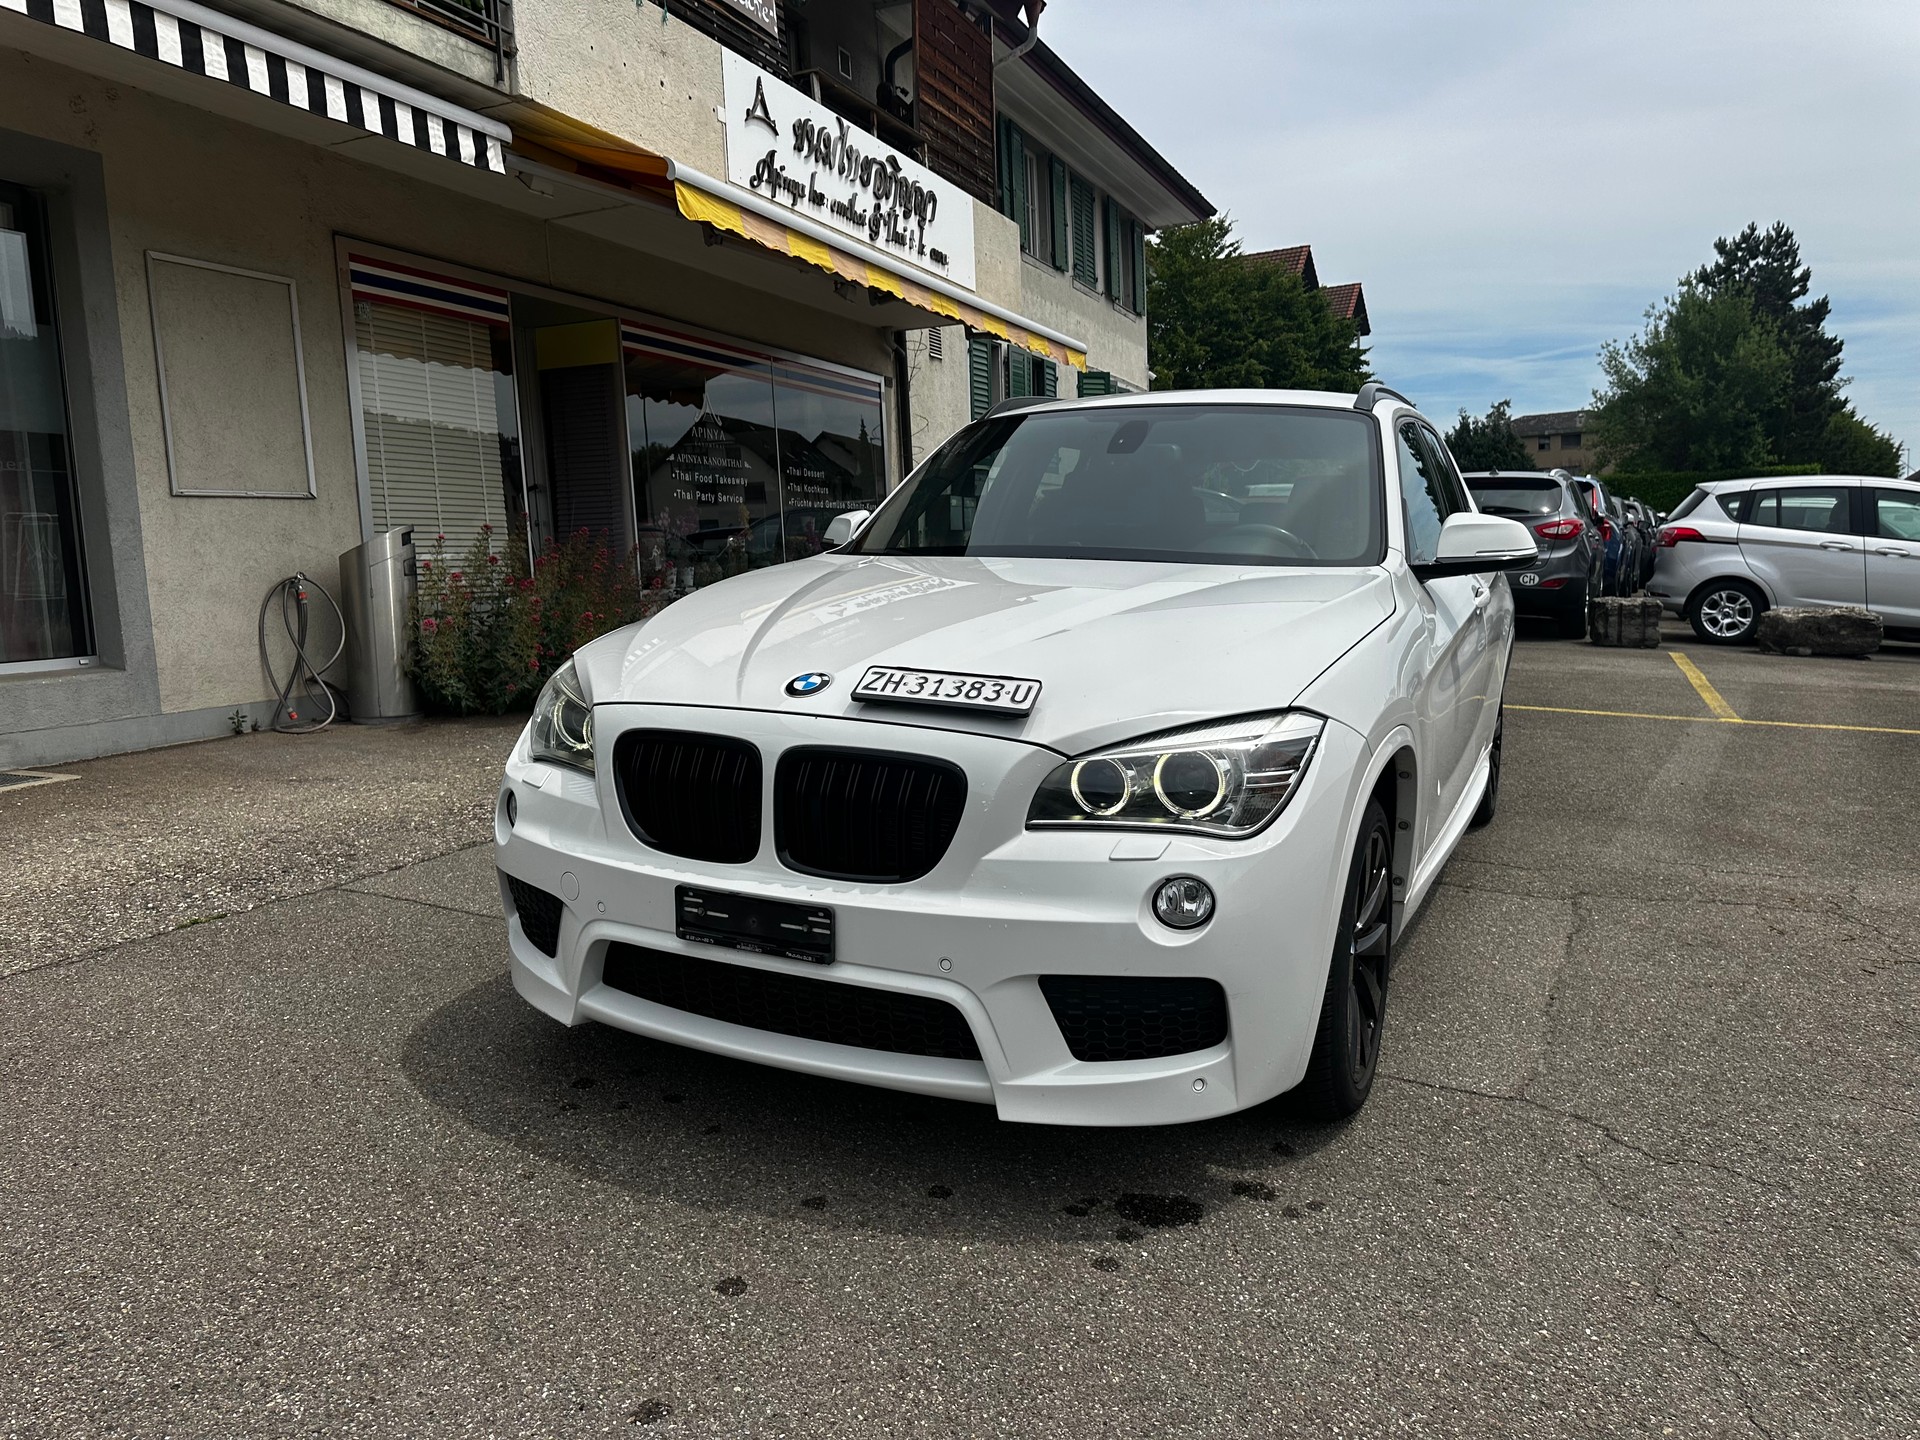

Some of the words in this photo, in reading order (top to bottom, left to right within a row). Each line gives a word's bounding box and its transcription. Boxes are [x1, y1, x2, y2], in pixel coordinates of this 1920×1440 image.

[749, 149, 806, 207] Apinya
[692, 426, 726, 441] APINYA
[676, 453, 702, 465] APINYA
[675, 470, 692, 481] Thai
[694, 472, 713, 483] Food
[715, 474, 748, 487] Takeaway
[788, 466, 802, 476] Thai
[803, 468, 825, 479] Dessert
[790, 482, 802, 492] Thai
[803, 484, 829, 494] Kochkurs
[676, 489, 693, 500] Thai
[696, 491, 715, 503] Party
[717, 492, 744, 503] Service
[813, 500, 824, 508] und
[1521, 574, 1536, 585] CH
